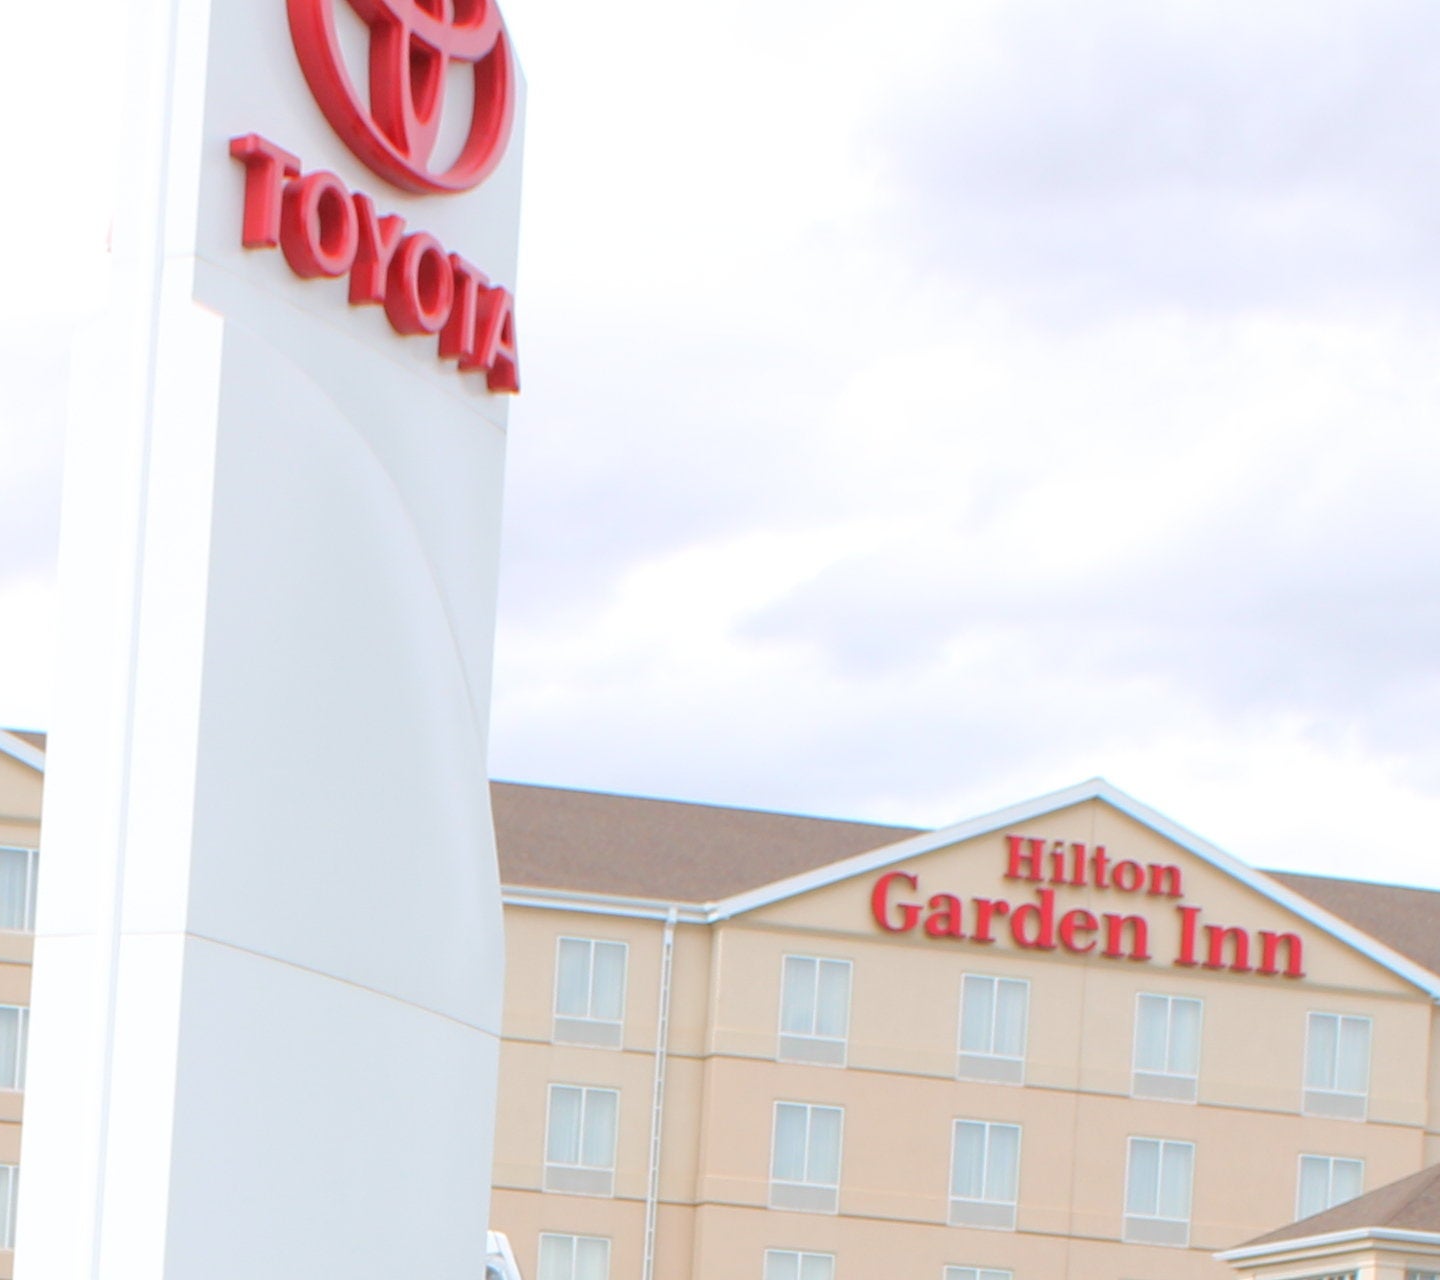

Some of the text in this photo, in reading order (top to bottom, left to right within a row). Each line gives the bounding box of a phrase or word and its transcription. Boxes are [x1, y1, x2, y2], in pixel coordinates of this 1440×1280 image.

[229, 132, 520, 393] TOYOTA
[1004, 834, 1184, 898] Hilton
[870, 869, 1307, 978] Garden Inn
